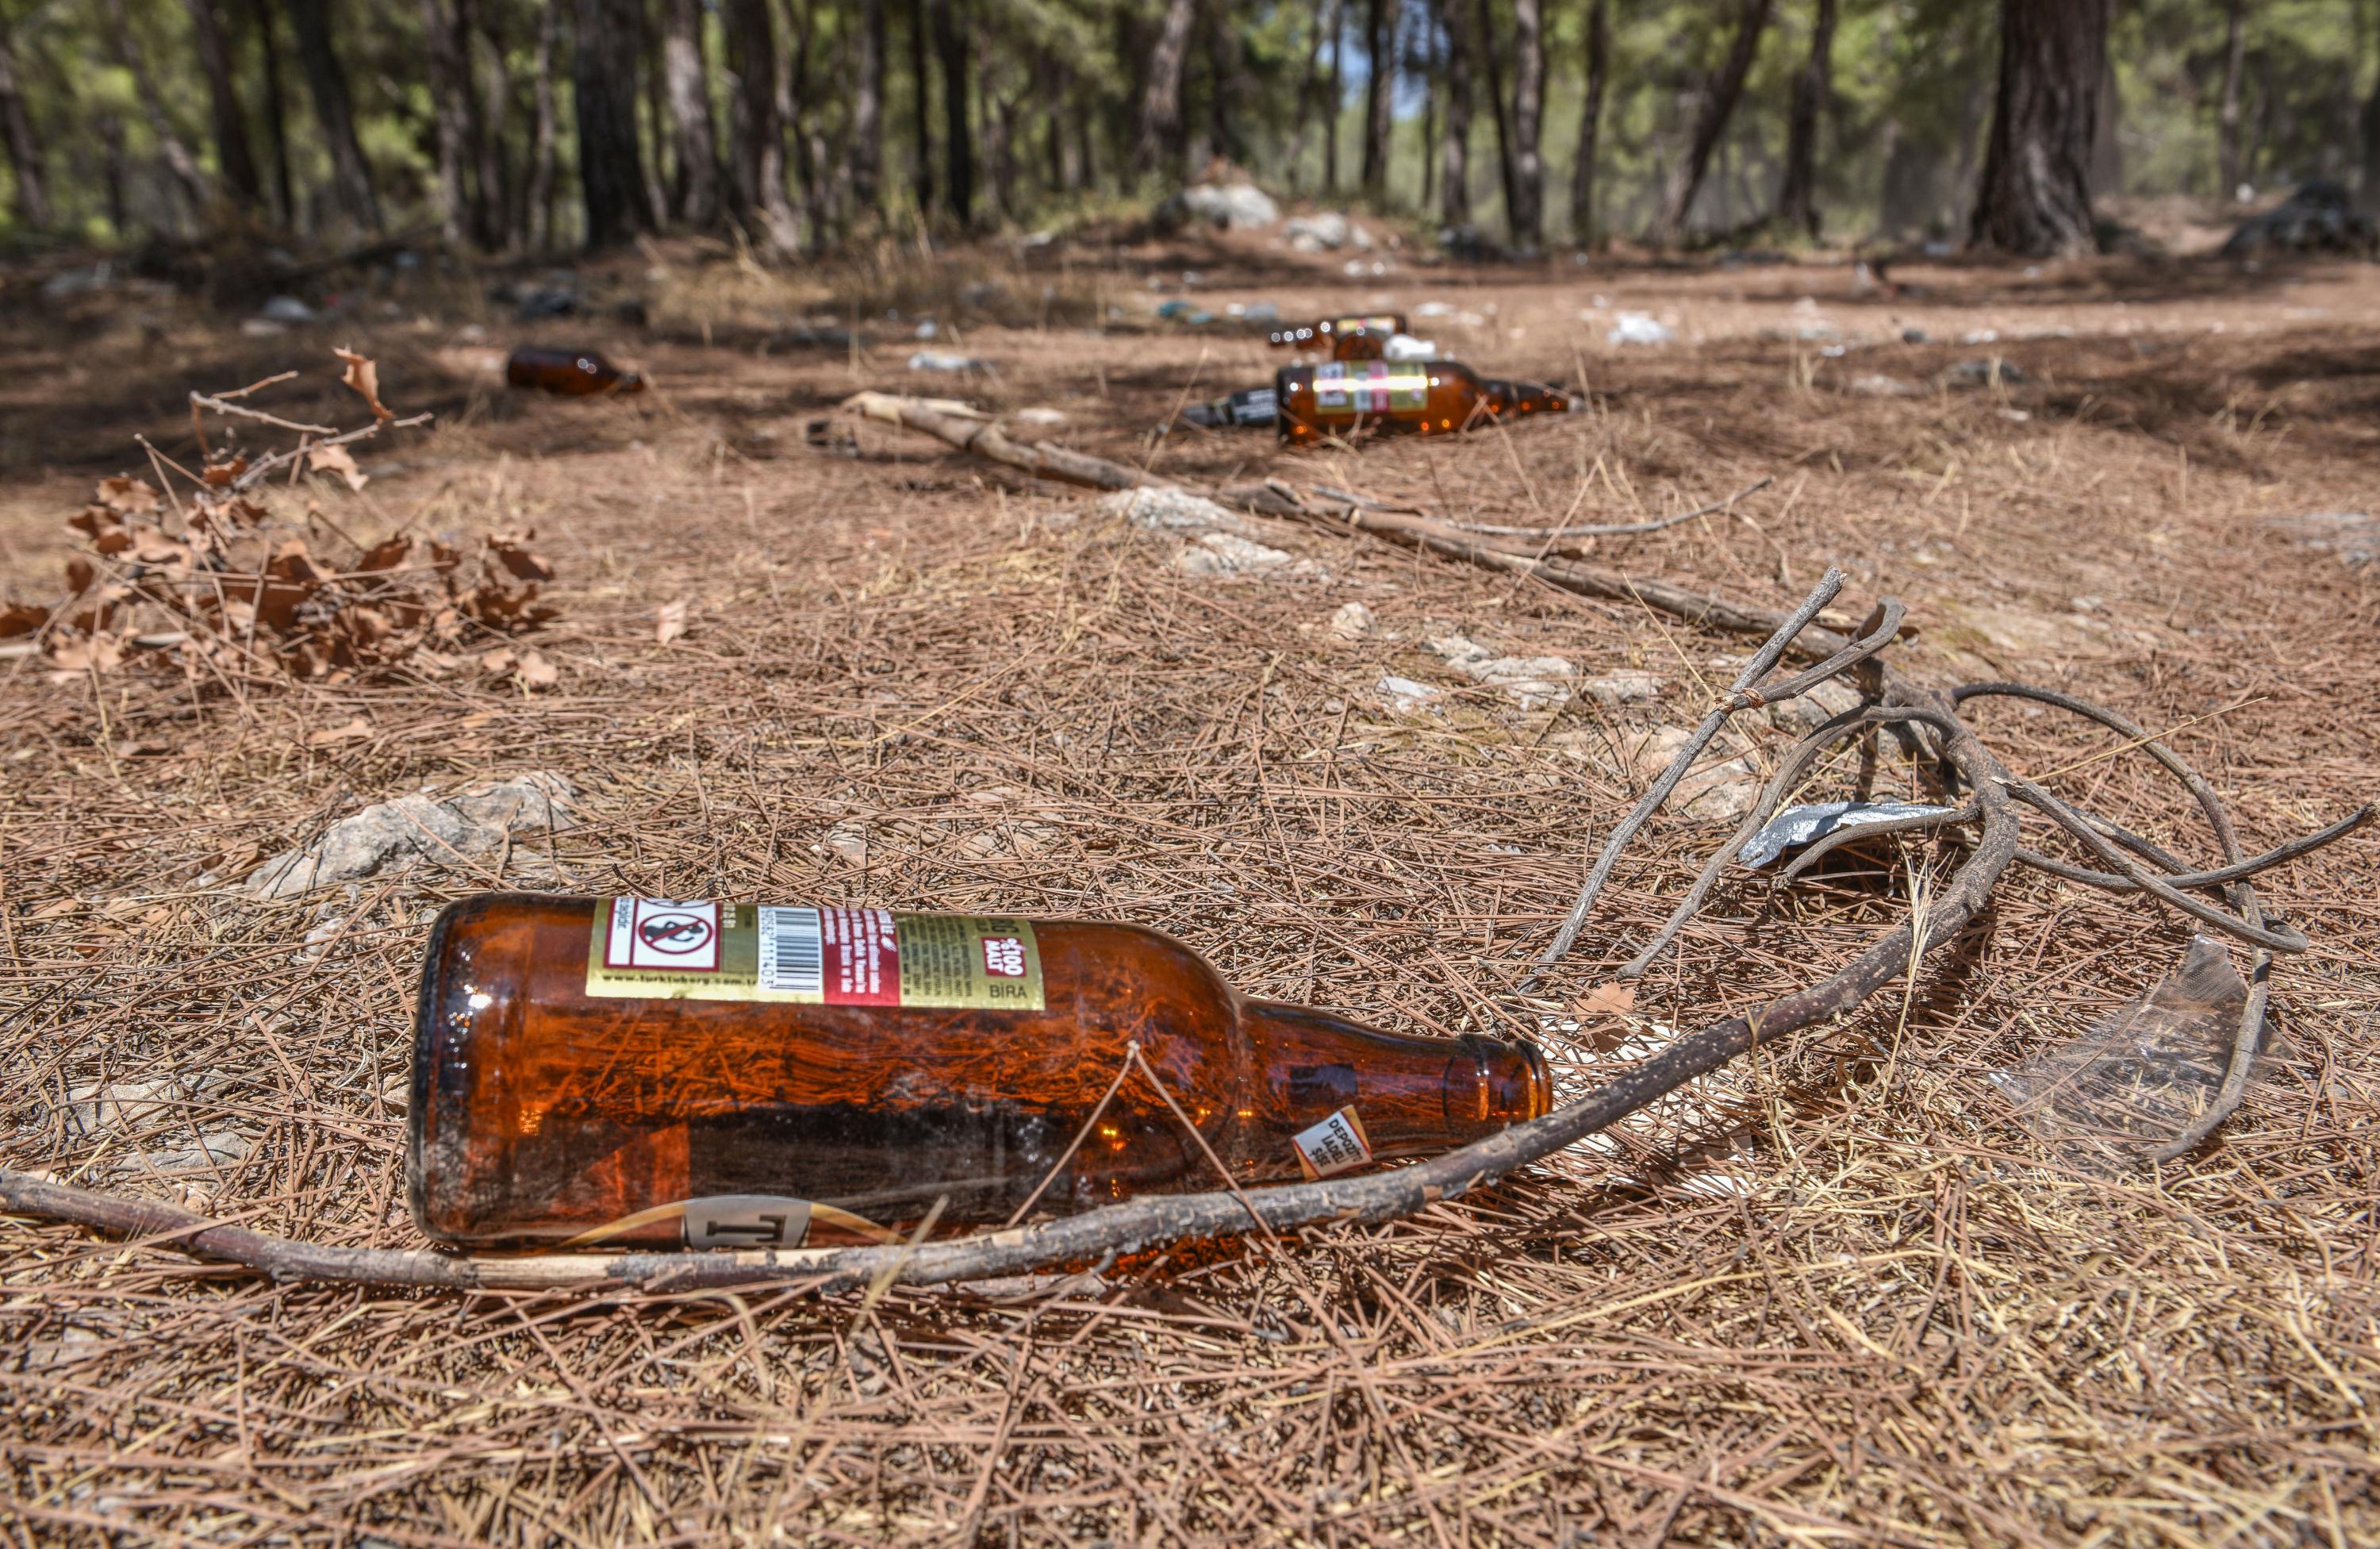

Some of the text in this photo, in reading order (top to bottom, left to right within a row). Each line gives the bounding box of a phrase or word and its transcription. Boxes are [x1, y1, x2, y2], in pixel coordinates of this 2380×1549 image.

[984, 940, 1004, 972] MALT
[1000, 938, 1023, 975] %100
[989, 982, 1027, 998] BİRA
